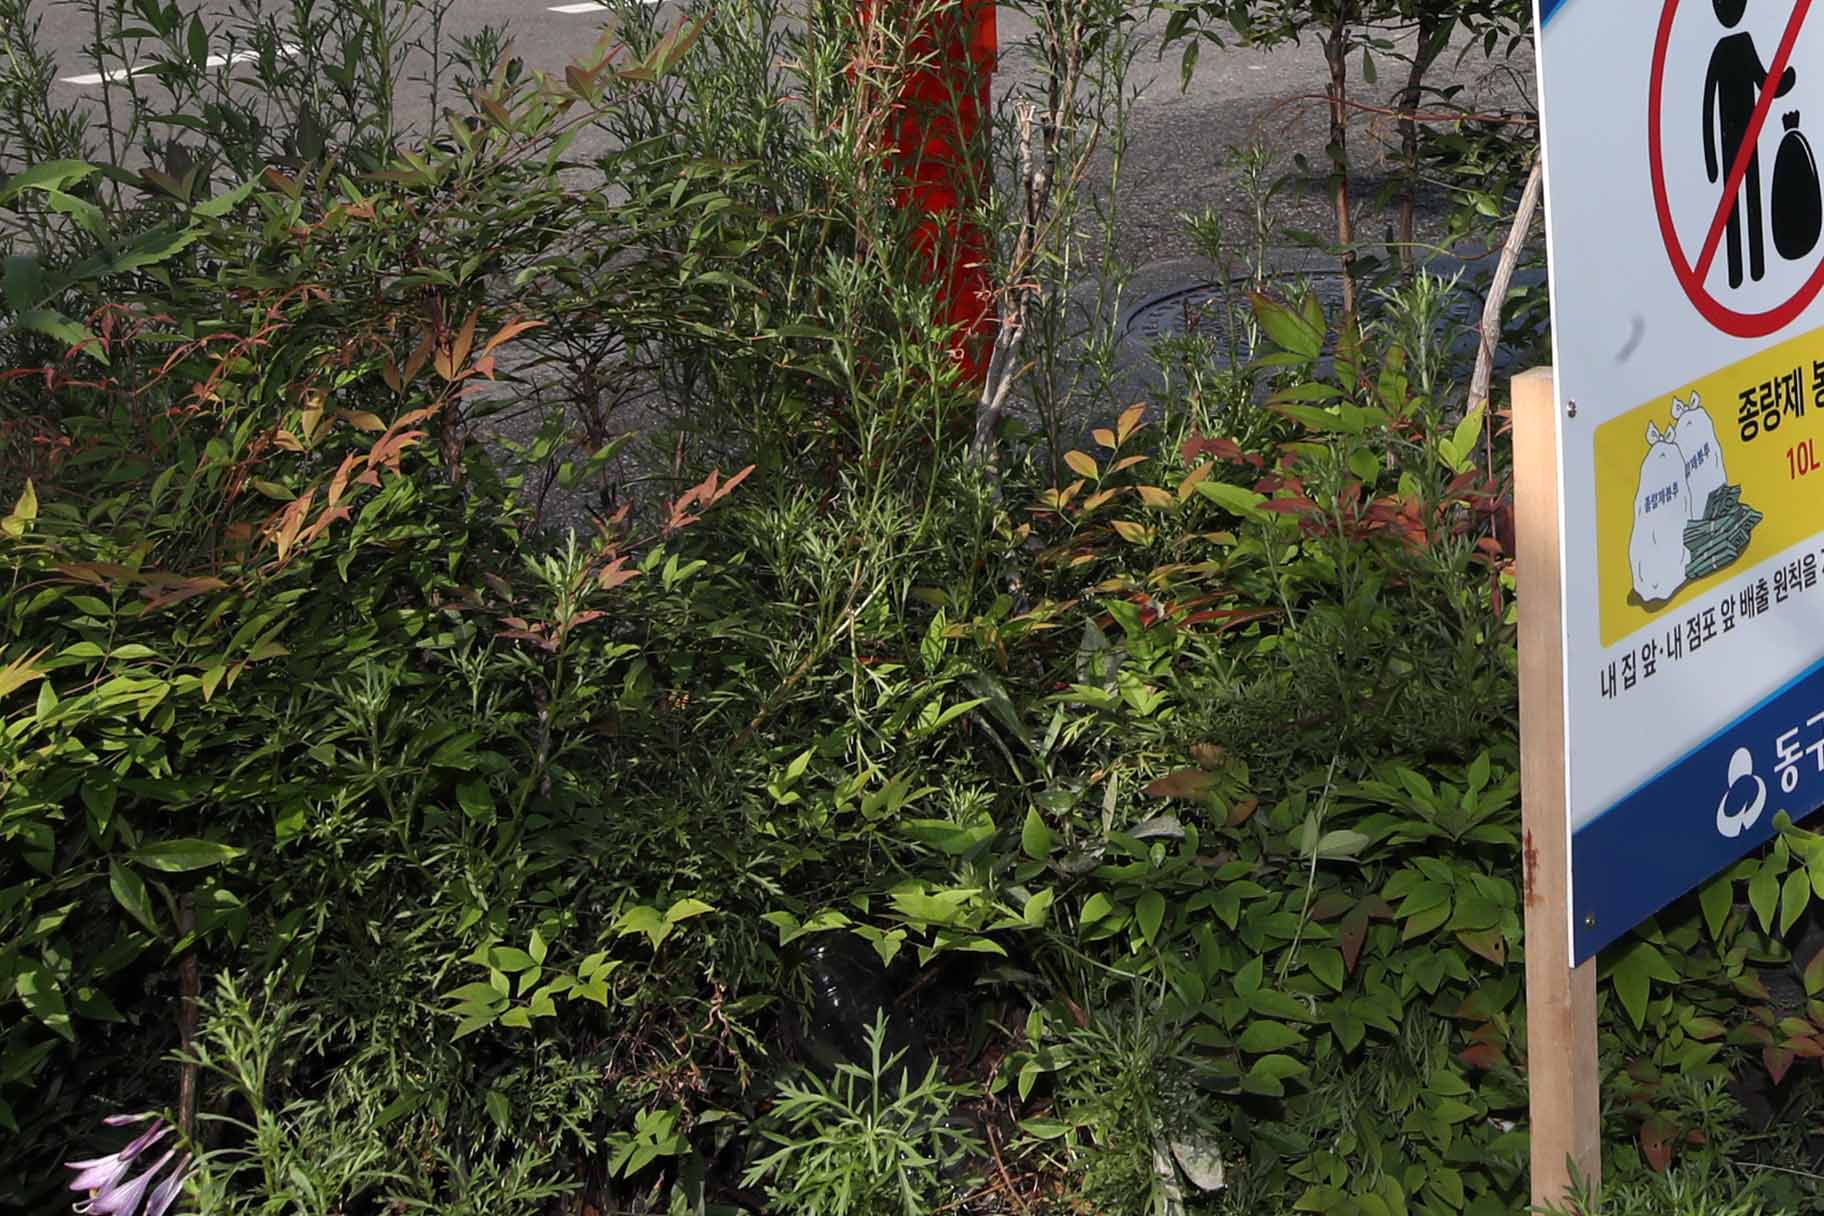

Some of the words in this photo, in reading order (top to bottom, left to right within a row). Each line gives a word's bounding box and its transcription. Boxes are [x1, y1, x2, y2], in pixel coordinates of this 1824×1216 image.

[1738, 366, 1805, 442] 종량제
[1786, 439, 1821, 481] 10L
[1600, 661, 1618, 700] 내
[1621, 650, 1637, 691] 집
[1686, 606, 1718, 653] 점포
[1720, 595, 1736, 634] 앞
[1739, 578, 1770, 619] 배출
[1773, 553, 1818, 604] 원칙을
